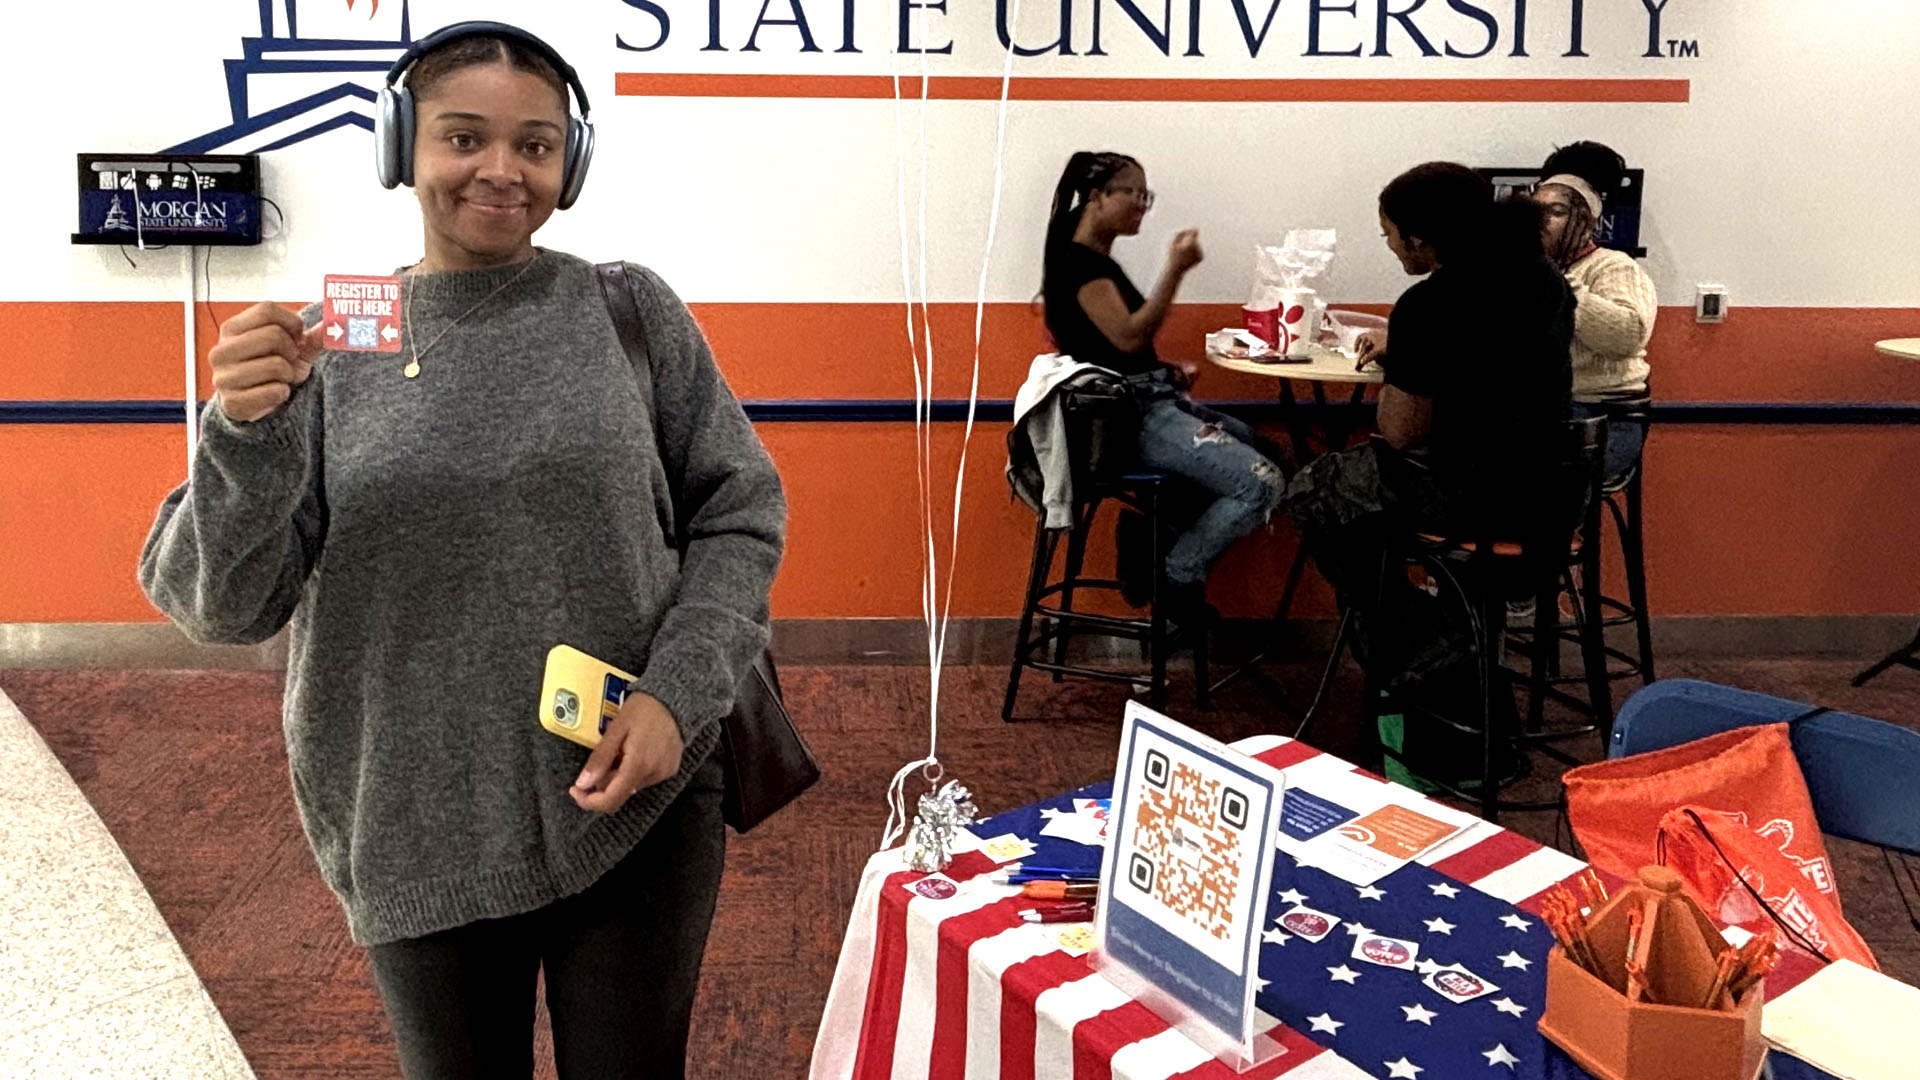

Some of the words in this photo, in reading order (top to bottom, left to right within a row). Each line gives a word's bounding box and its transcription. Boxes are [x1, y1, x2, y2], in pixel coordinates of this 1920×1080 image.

[616, 0, 953, 54] STATE
[139, 201, 227, 218] MORGAN
[140, 218, 166, 227] STATE
[168, 218, 225, 228] UNIVRSITY
[327, 282, 381, 299] REGISTER
[383, 284, 398, 300] TO
[332, 299, 361, 315] VOTE
[363, 300, 392, 316] HERE
